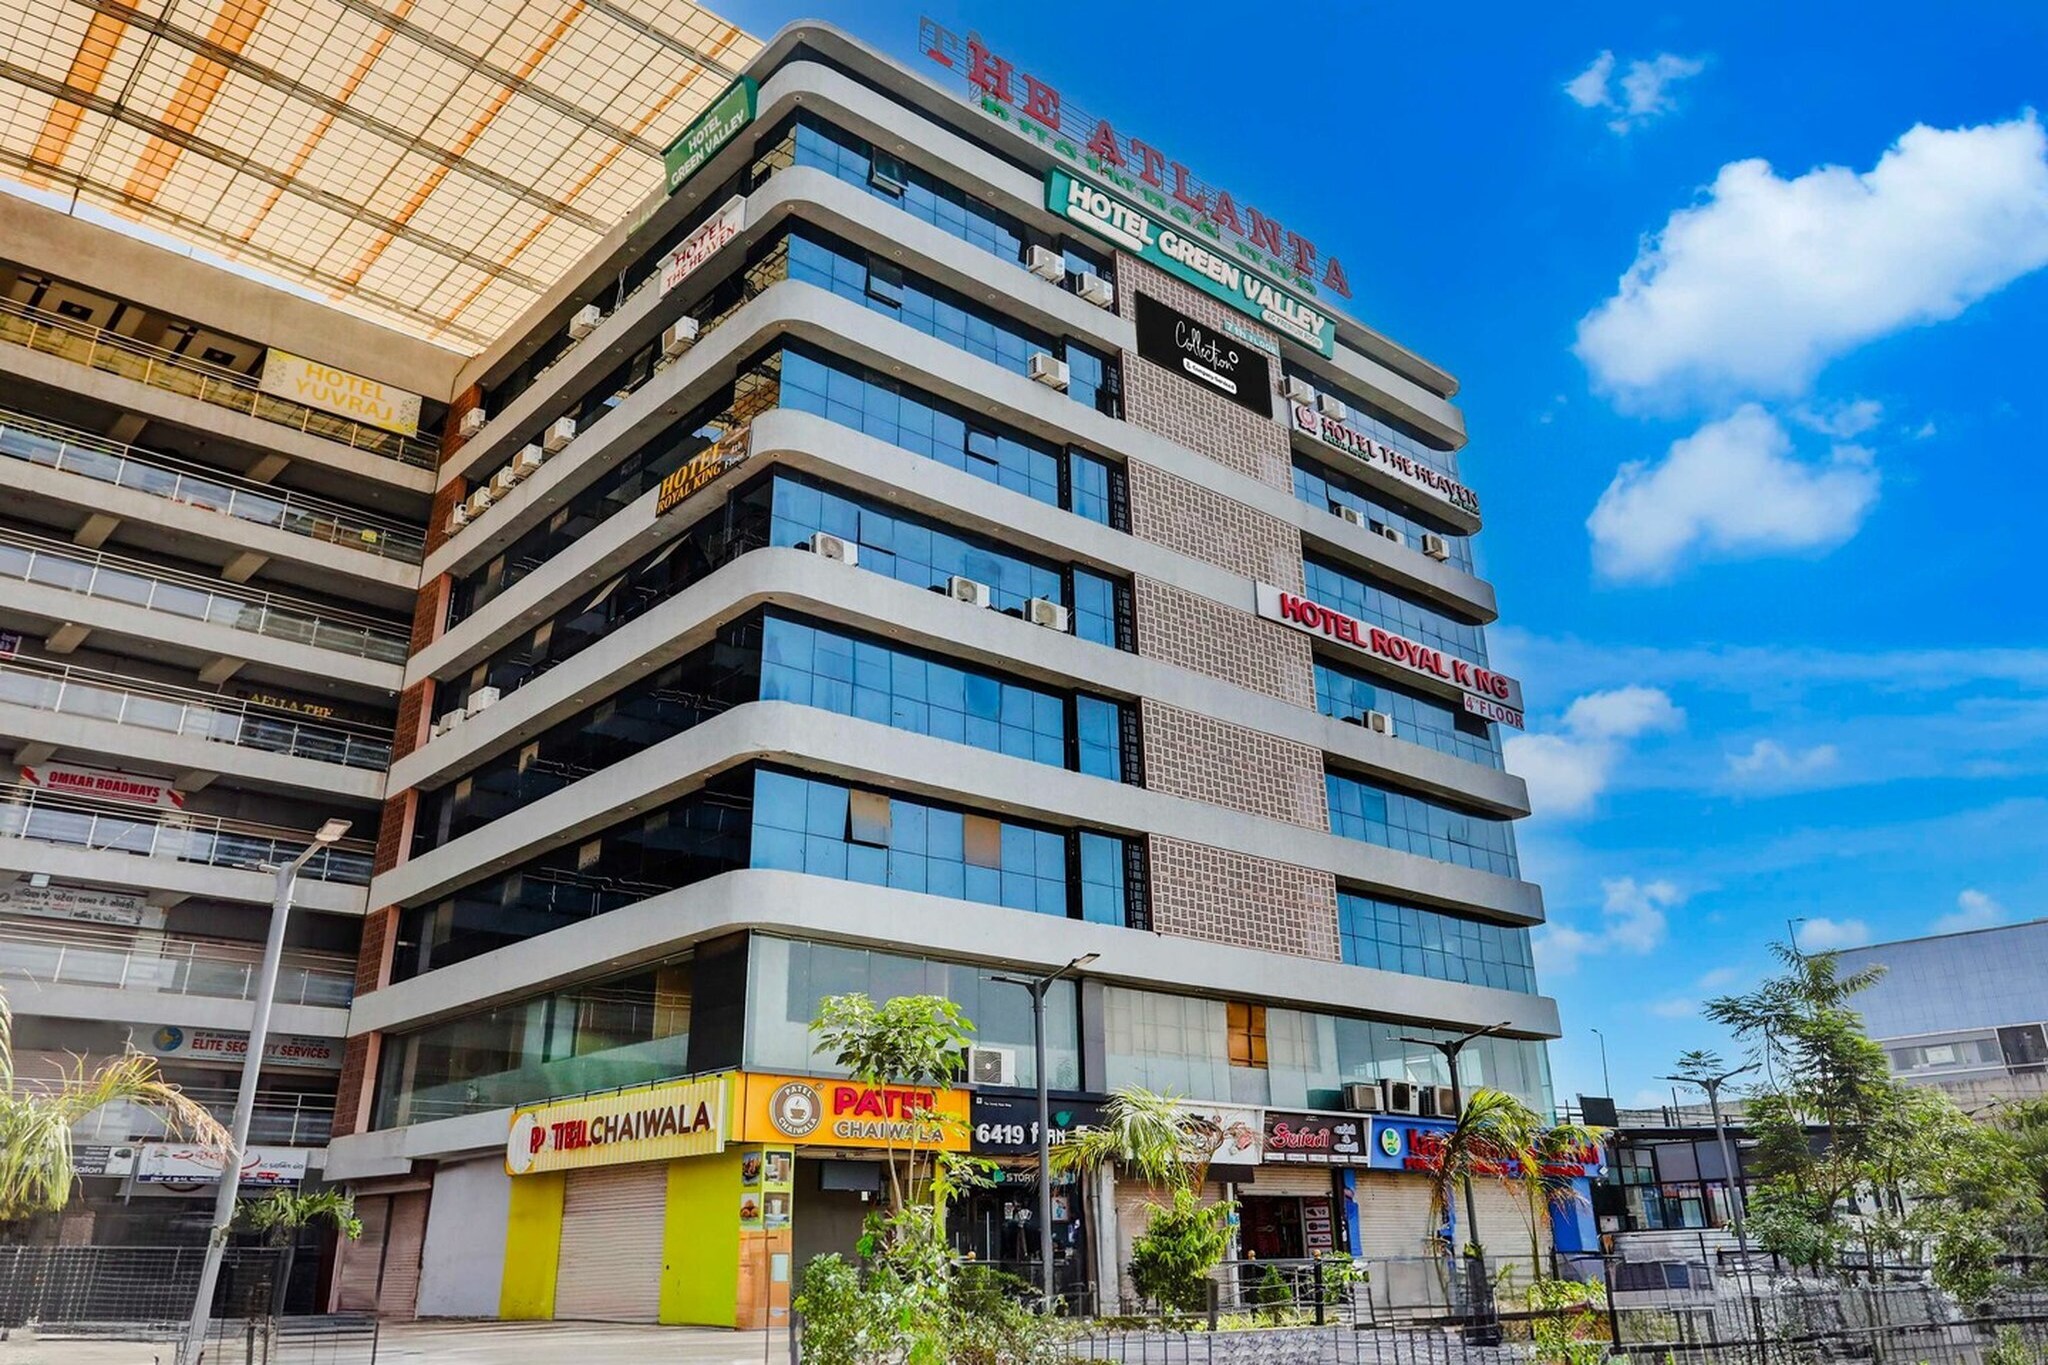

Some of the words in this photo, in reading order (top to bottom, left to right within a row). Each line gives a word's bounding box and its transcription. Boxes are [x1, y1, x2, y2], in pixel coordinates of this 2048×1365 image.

[671, 152, 704, 187] GREEN
[705, 109, 745, 153] VALLEY
[688, 114, 722, 154] HOTEL
[1086, 119, 1352, 299] ATLANTA
[665, 260, 687, 289] THE
[688, 221, 736, 272] HEAVEN
[674, 217, 724, 269] HOTEL
[1067, 179, 1154, 247] HOTEL
[1158, 230, 1241, 293] GREEN
[1242, 274, 1326, 337] VALLEY
[296, 379, 393, 422] YUVRAJ
[306, 363, 385, 402] HOTEL
[660, 440, 723, 500] HOTEL
[1322, 415, 1379, 459] HOTEL
[1378, 444, 1414, 478] THE
[1414, 463, 1480, 509] HEAVEN
[657, 482, 692, 515] ROYAL
[693, 463, 721, 490] KING
[1280, 592, 1368, 648] HOTEL
[1370, 628, 1450, 679] ROYAL
[1479, 700, 1526, 729] FLOOR
[49, 770, 94, 788] OMKAR
[95, 778, 161, 798] ROADWAYS
[192, 1037, 223, 1051] ELITE
[280, 1045, 331, 1060] SERVICES
[784, 1085, 812, 1097] PATEL
[833, 1087, 937, 1120] PATEL
[590, 1101, 711, 1146] CHAIWALA
[778, 1117, 818, 1134] CHAIWALA
[835, 1121, 945, 1142] CHAIWALA
[976, 1123, 1024, 1145] 6419
[1006, 1173, 1036, 1183] STORY
